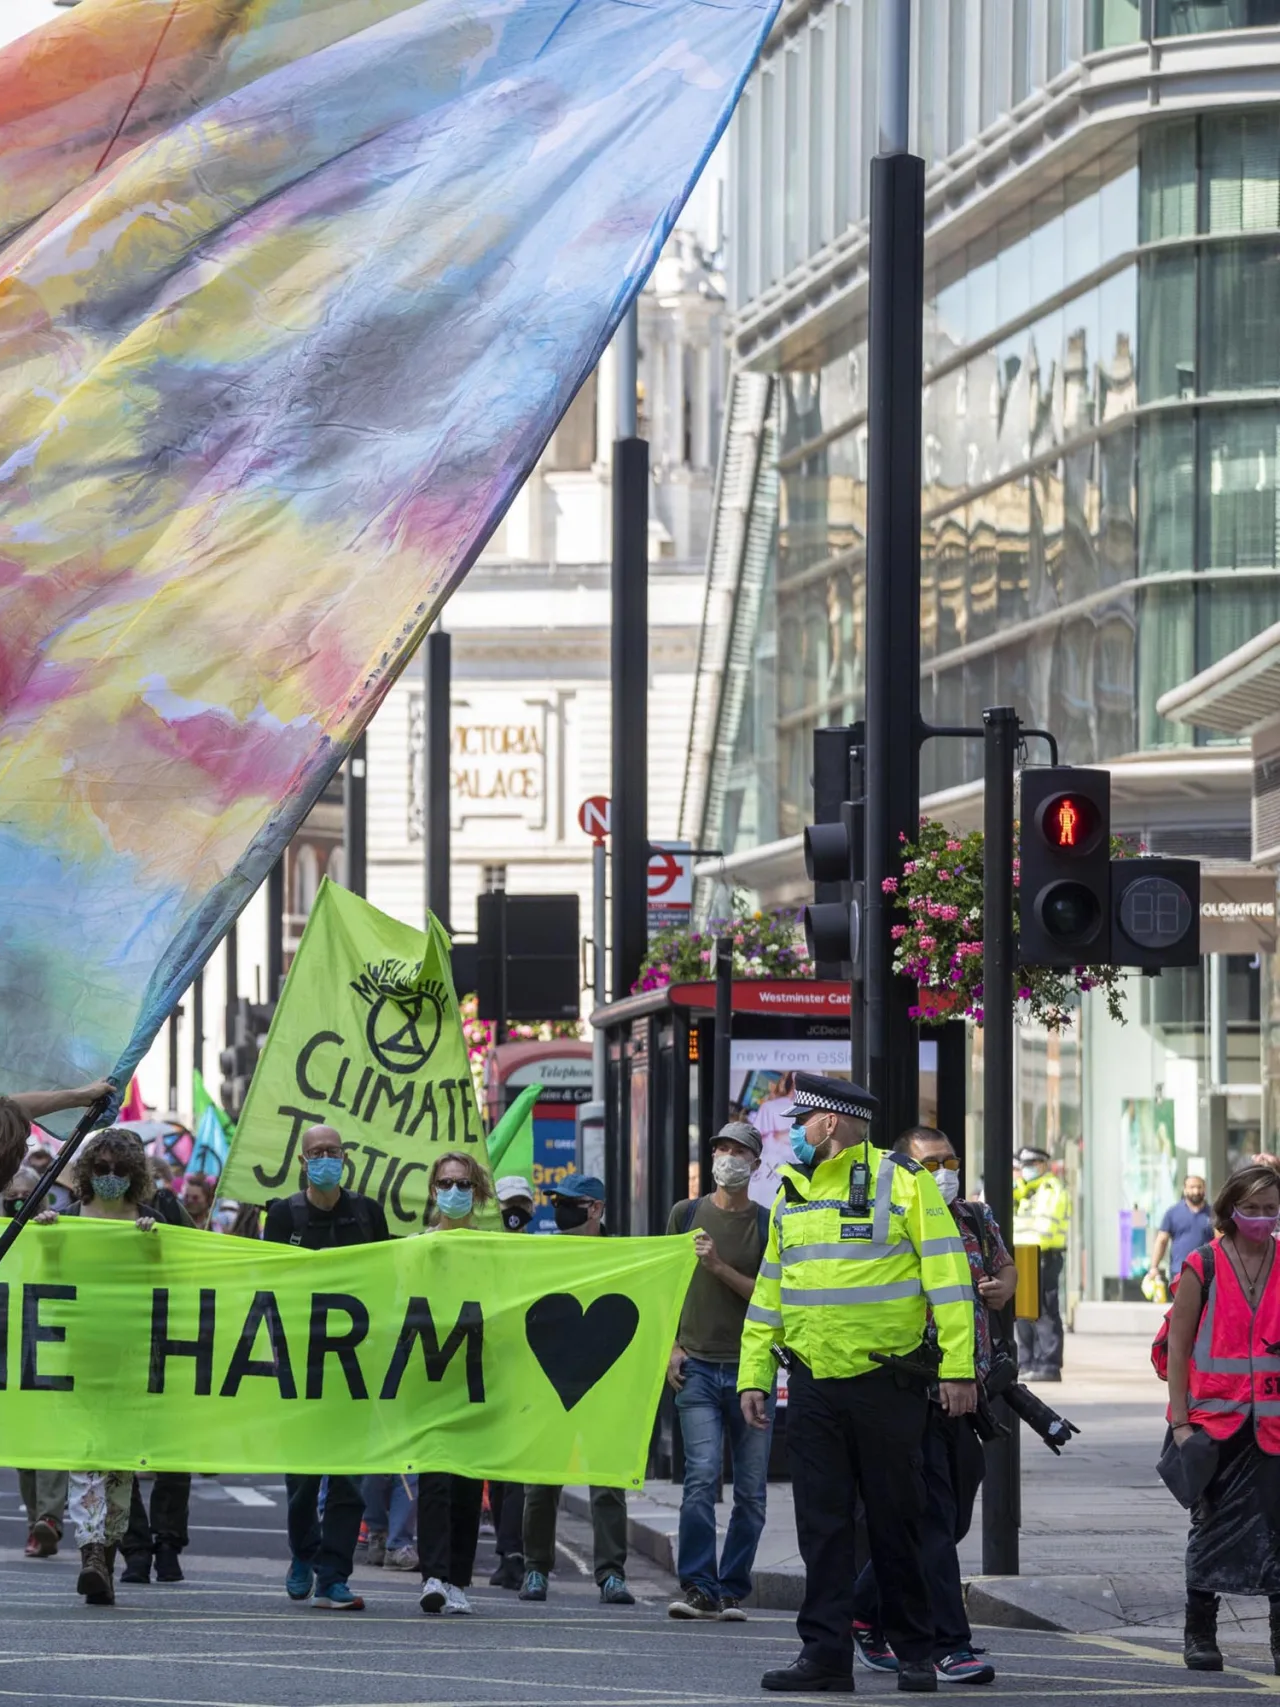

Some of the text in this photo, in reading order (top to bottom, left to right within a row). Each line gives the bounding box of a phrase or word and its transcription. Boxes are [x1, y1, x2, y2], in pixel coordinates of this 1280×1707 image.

[584, 801, 611, 833] N
[1200, 902, 1275, 917] OLDSMITHS
[759, 991, 852, 1005] Westminster Cath
[736, 1051, 768, 1062] new
[774, 1050, 810, 1062] from
[539, 1065, 593, 1081] Telephon
[296, 1030, 478, 1143] CLIMATE
[541, 1091, 562, 1101] oins
[252, 1105, 433, 1227] JSTIC
[925, 1208, 945, 1217] POLICE
[147, 1287, 486, 1403] HARM
